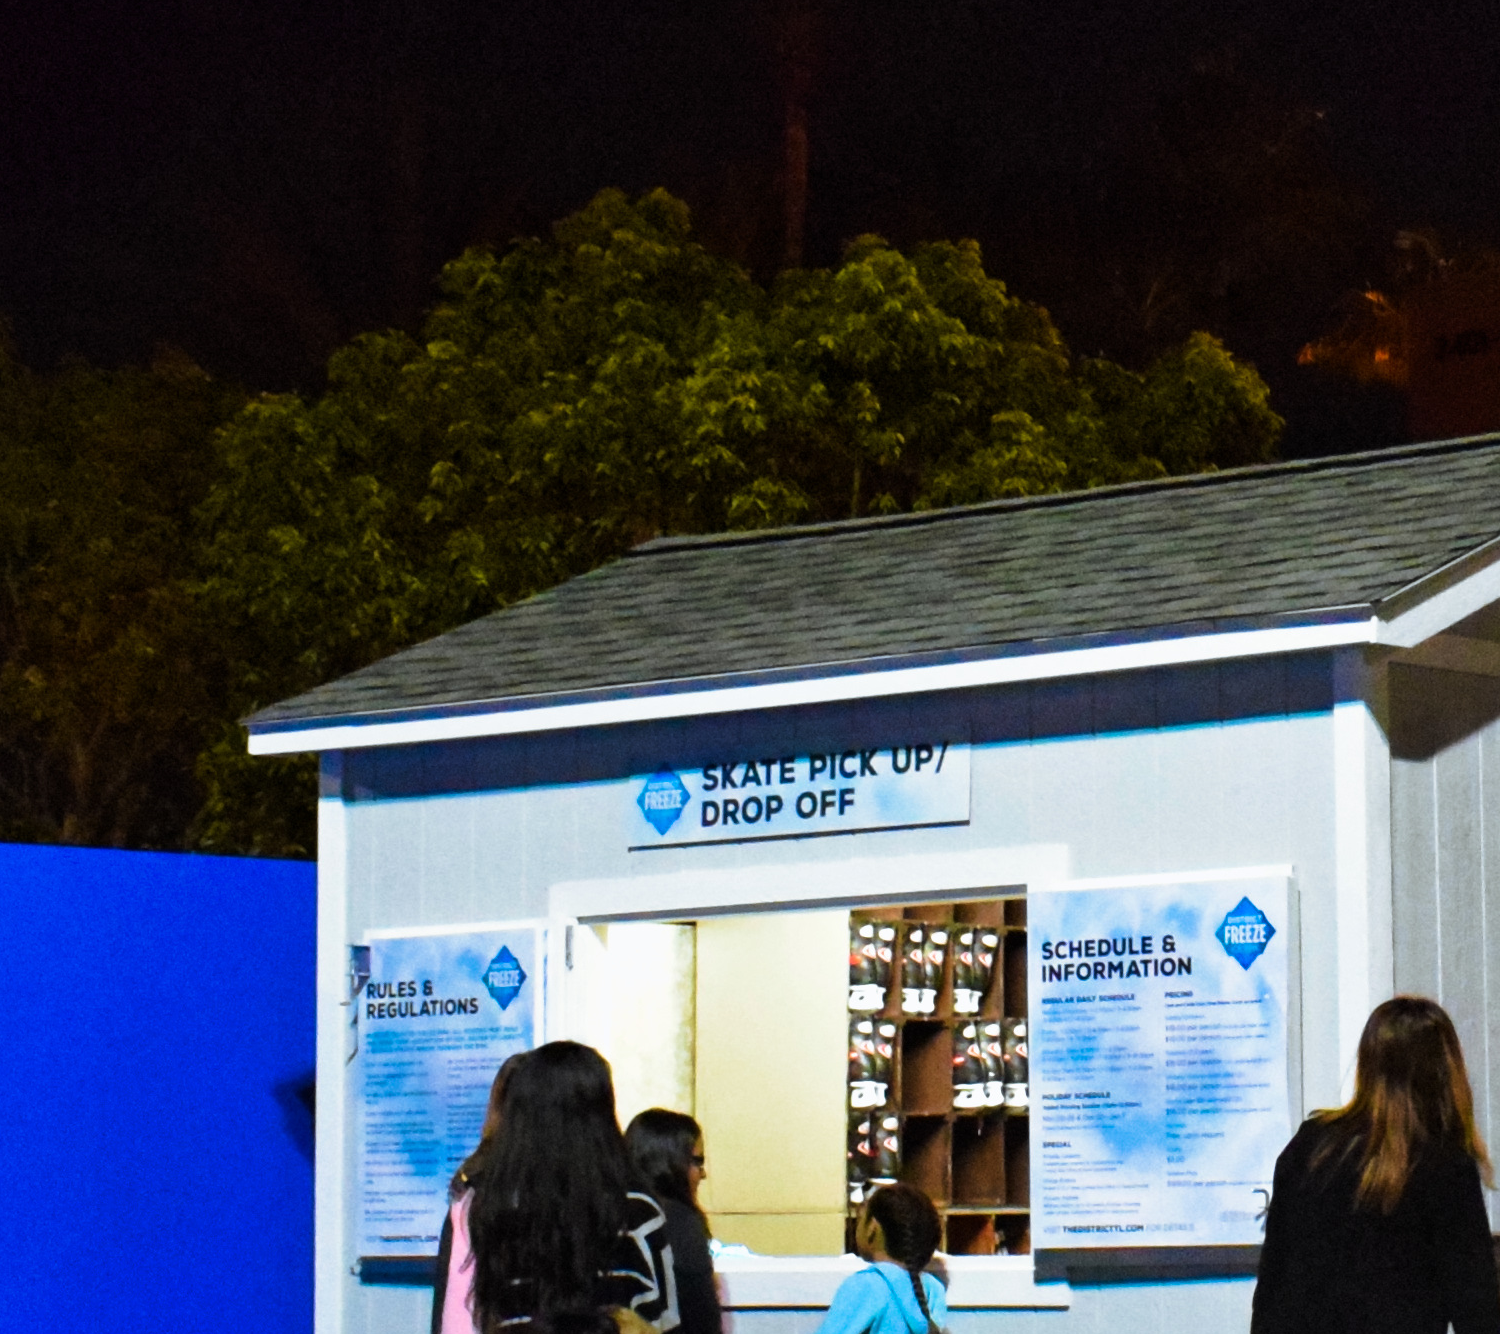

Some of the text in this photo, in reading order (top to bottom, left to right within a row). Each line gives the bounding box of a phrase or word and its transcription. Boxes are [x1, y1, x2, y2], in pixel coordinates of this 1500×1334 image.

[701, 741, 949, 791] SKATE PICK UP/
[700, 788, 855, 828] DROP OFF
[1224, 923, 1267, 945] FREEZE
[1041, 935, 1176, 961] SCHEDULE &
[1041, 956, 1193, 983] INFORMATION
[366, 979, 434, 999] RULES &
[366, 997, 479, 1020] REGULATIONS
